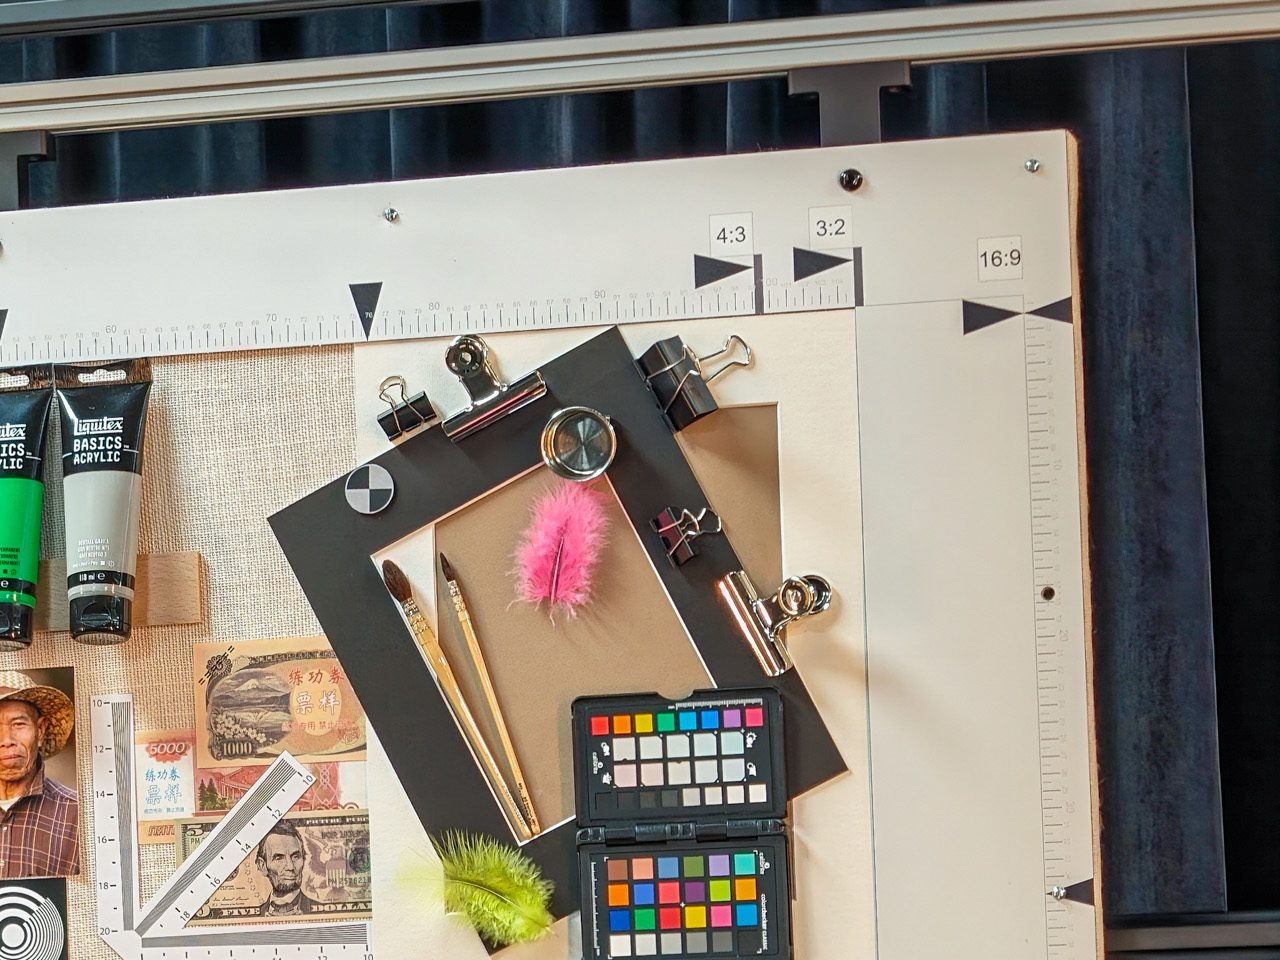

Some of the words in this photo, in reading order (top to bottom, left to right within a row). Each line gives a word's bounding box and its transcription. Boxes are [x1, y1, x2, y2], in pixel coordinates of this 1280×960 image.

[716, 225, 747, 244] 4:3
[816, 218, 846, 237] 3:2
[979, 248, 1022, 269] 16:9
[106, 325, 117, 334] 60
[266, 314, 277, 322] 70
[594, 290, 606, 299] 90
[74, 416, 124, 436] Liquitex
[74, 436, 122, 452] BASICS
[74, 450, 120, 465] ACRYLIC
[288, 666, 344, 686] 练功券
[296, 690, 340, 714] 票样
[150, 742, 185, 755] 5000
[223, 742, 252, 756] 1000
[145, 767, 180, 782] 练功券
[302, 775, 314, 786] 10
[272, 809, 283, 820] 12
[186, 824, 204, 837] 5
[97, 836, 107, 844] 16
[240, 843, 252, 854] 14
[99, 882, 109, 890] 18
[210, 878, 220, 888] 16
[180, 912, 191, 922] 18
[221, 908, 260, 916] FIVE
